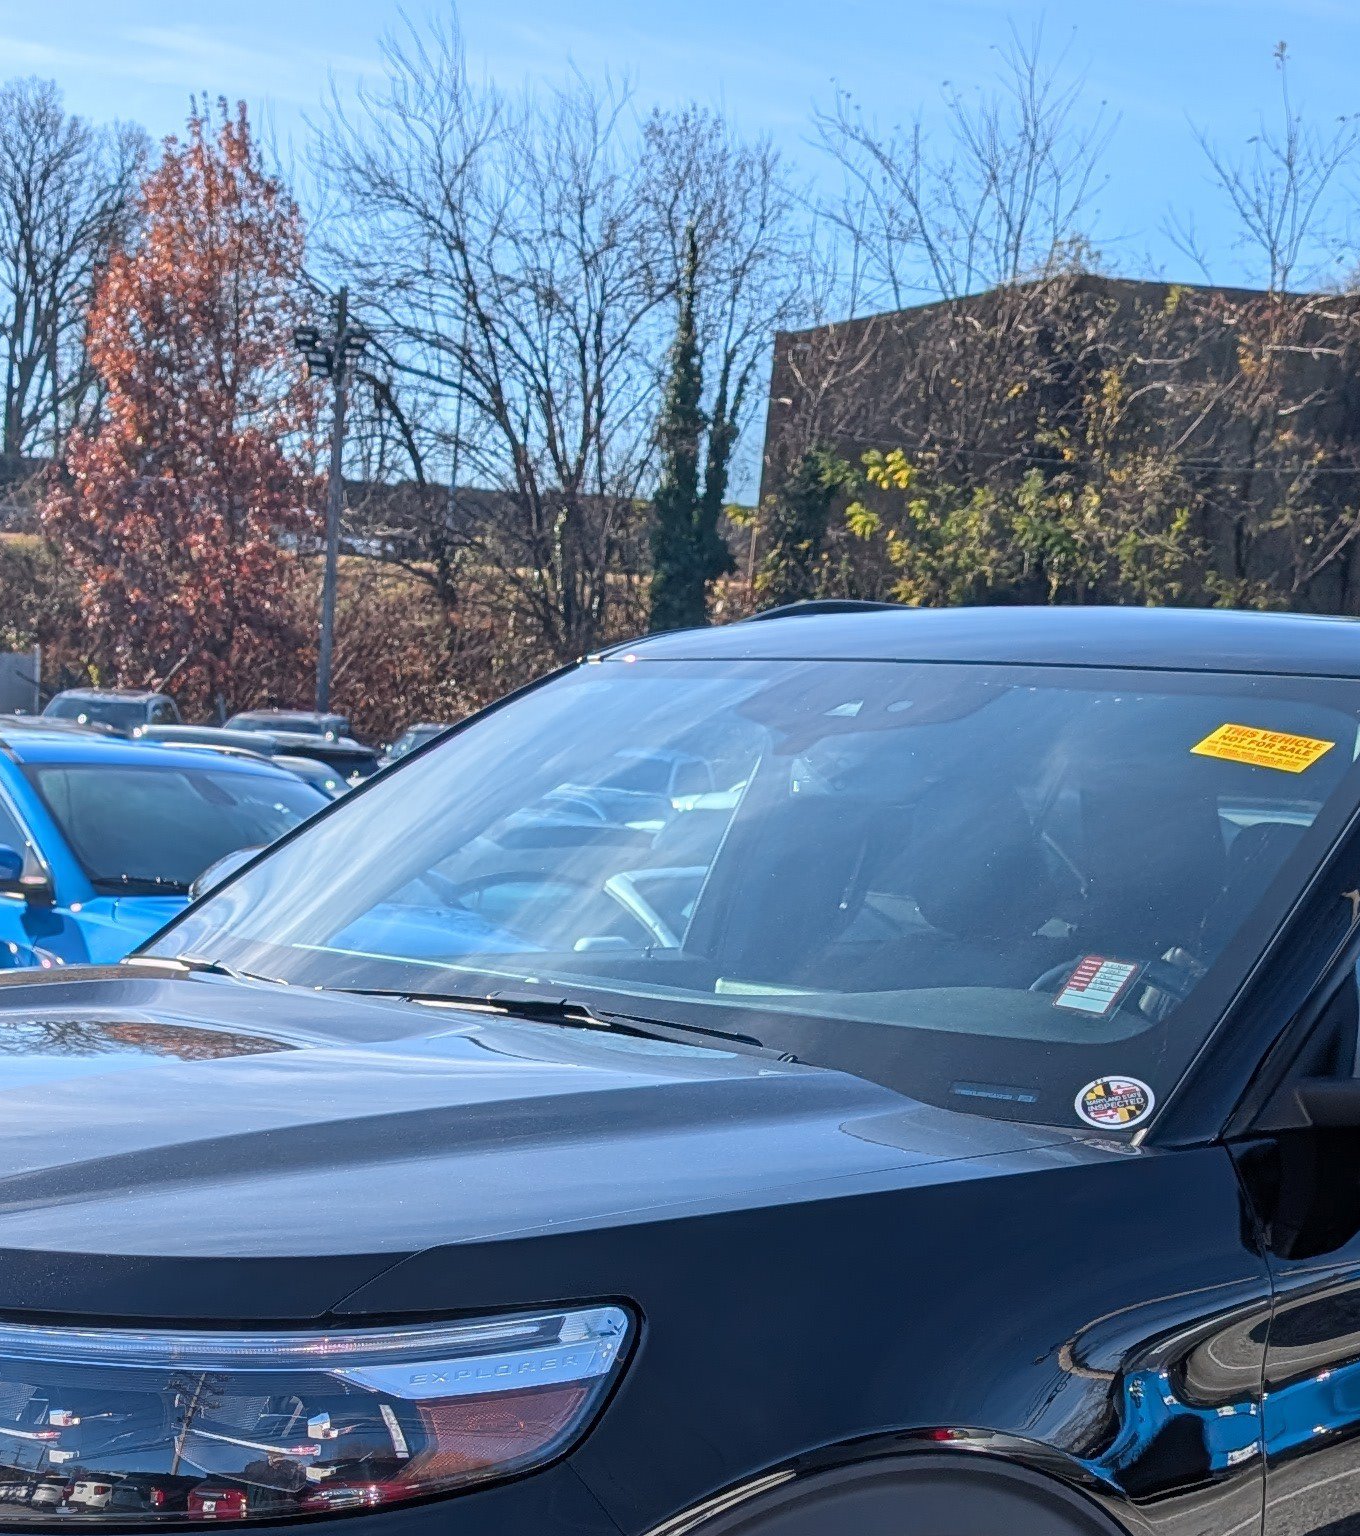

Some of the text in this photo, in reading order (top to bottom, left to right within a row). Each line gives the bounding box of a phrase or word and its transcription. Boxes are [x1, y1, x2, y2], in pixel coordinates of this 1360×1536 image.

[1217, 734, 1245, 745] NOT
[1248, 739, 1277, 750] FOR
[1277, 744, 1314, 757] SALE
[1223, 726, 1327, 751] THIS VEHICLE
[1085, 1091, 1143, 1106] MARYLAND STATE
[1087, 1097, 1145, 1112] INSPECTED
[408, 1353, 579, 1386] EXPLORER
